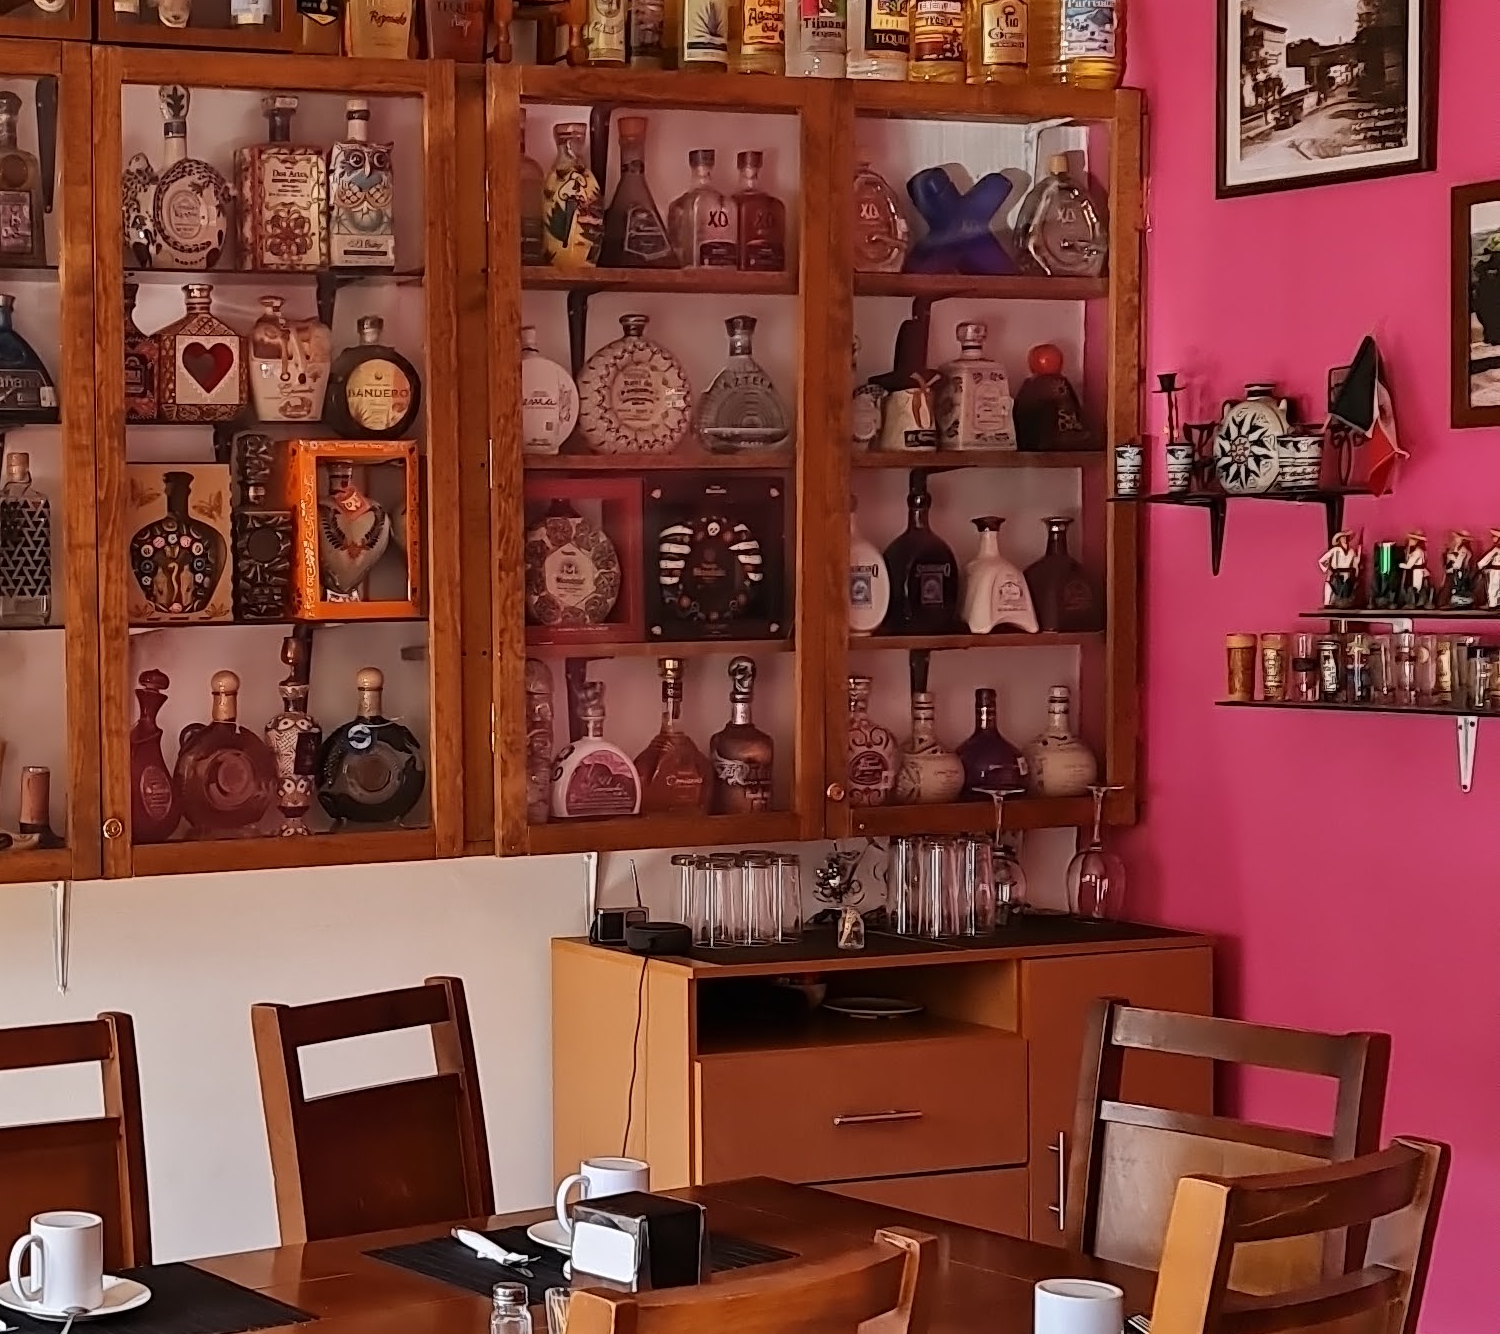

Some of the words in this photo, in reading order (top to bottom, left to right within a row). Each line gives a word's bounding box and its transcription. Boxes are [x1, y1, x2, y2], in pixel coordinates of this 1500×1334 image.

[803, 18, 845, 30] Tijuana
[860, 203, 879, 219] XO
[1057, 208, 1076, 223] XO
[708, 211, 728, 228] XO
[348, 388, 408, 398] BANDERO
